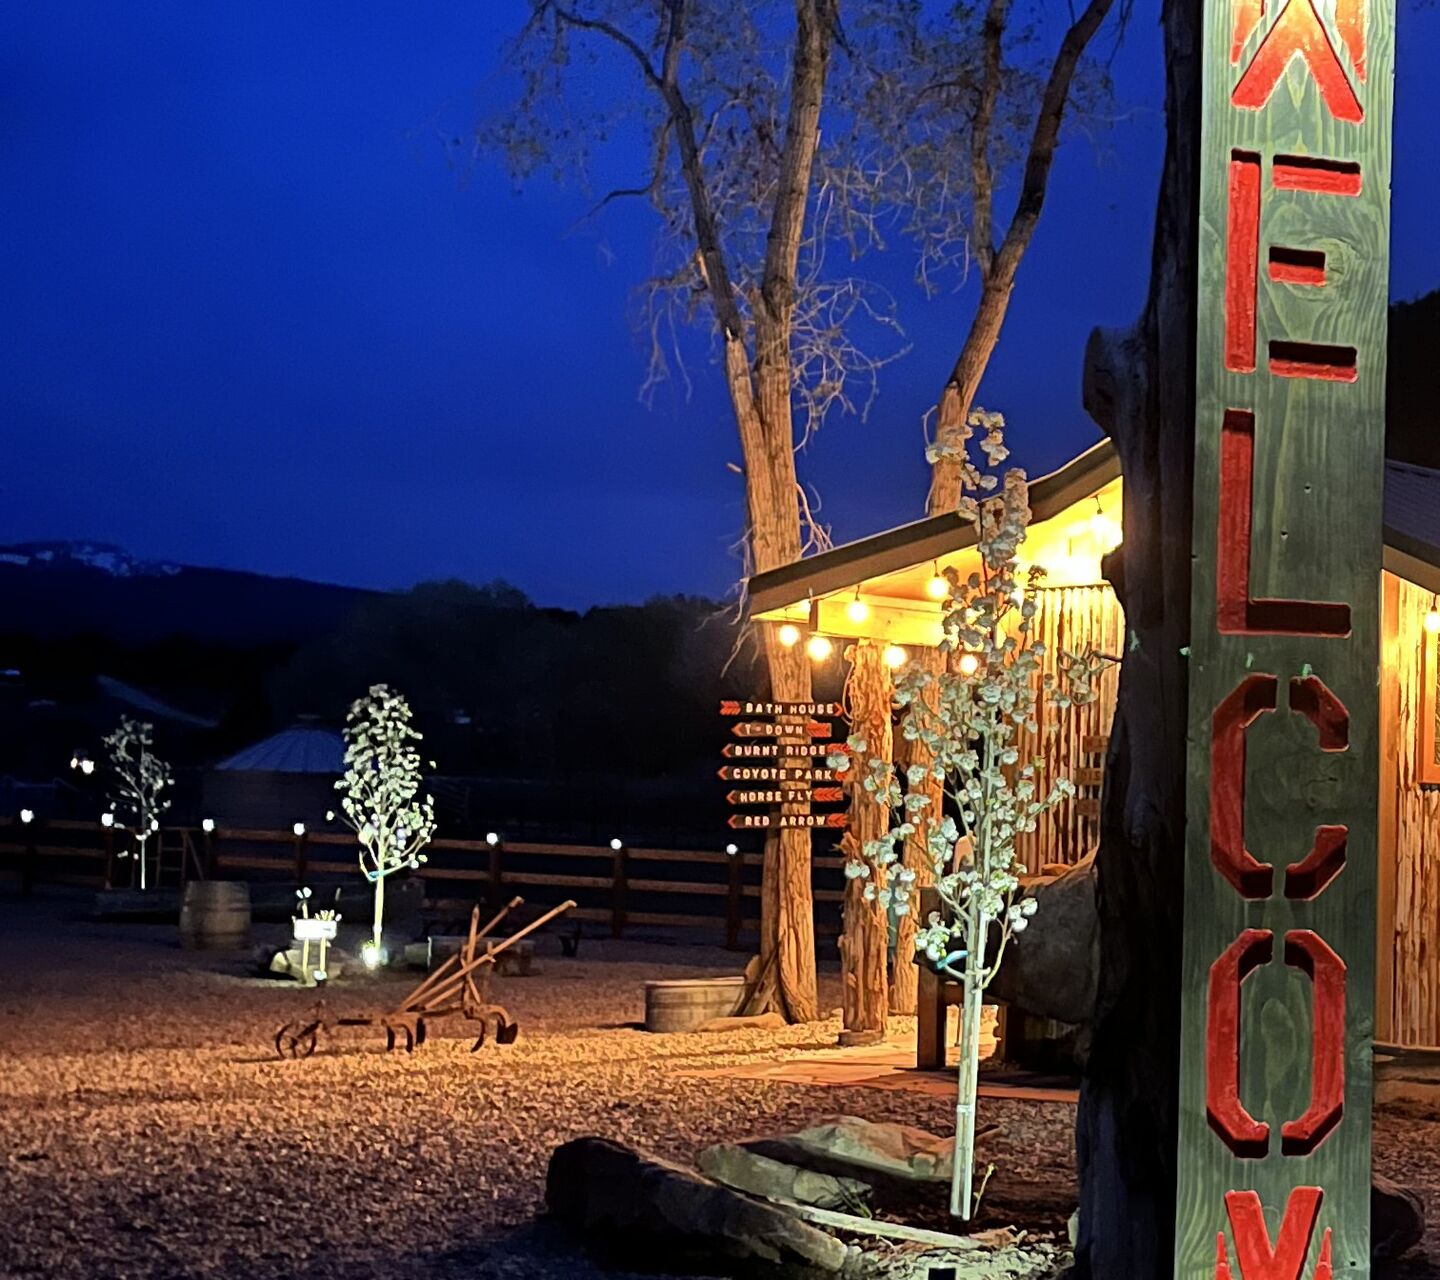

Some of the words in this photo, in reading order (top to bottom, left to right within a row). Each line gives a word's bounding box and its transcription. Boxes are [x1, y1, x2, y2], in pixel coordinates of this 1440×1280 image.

[746, 703, 783, 713] BATH
[790, 704, 834, 714] HOUSE
[735, 745, 778, 755] BURNT
[786, 745, 826, 755] RIDGE
[733, 769, 786, 779] COYOTE
[795, 770, 832, 779] PARK
[740, 792, 782, 801] HORSE
[788, 791, 813, 800] FLY
[745, 816, 770, 826] RED
[780, 816, 825, 826] ARROW
